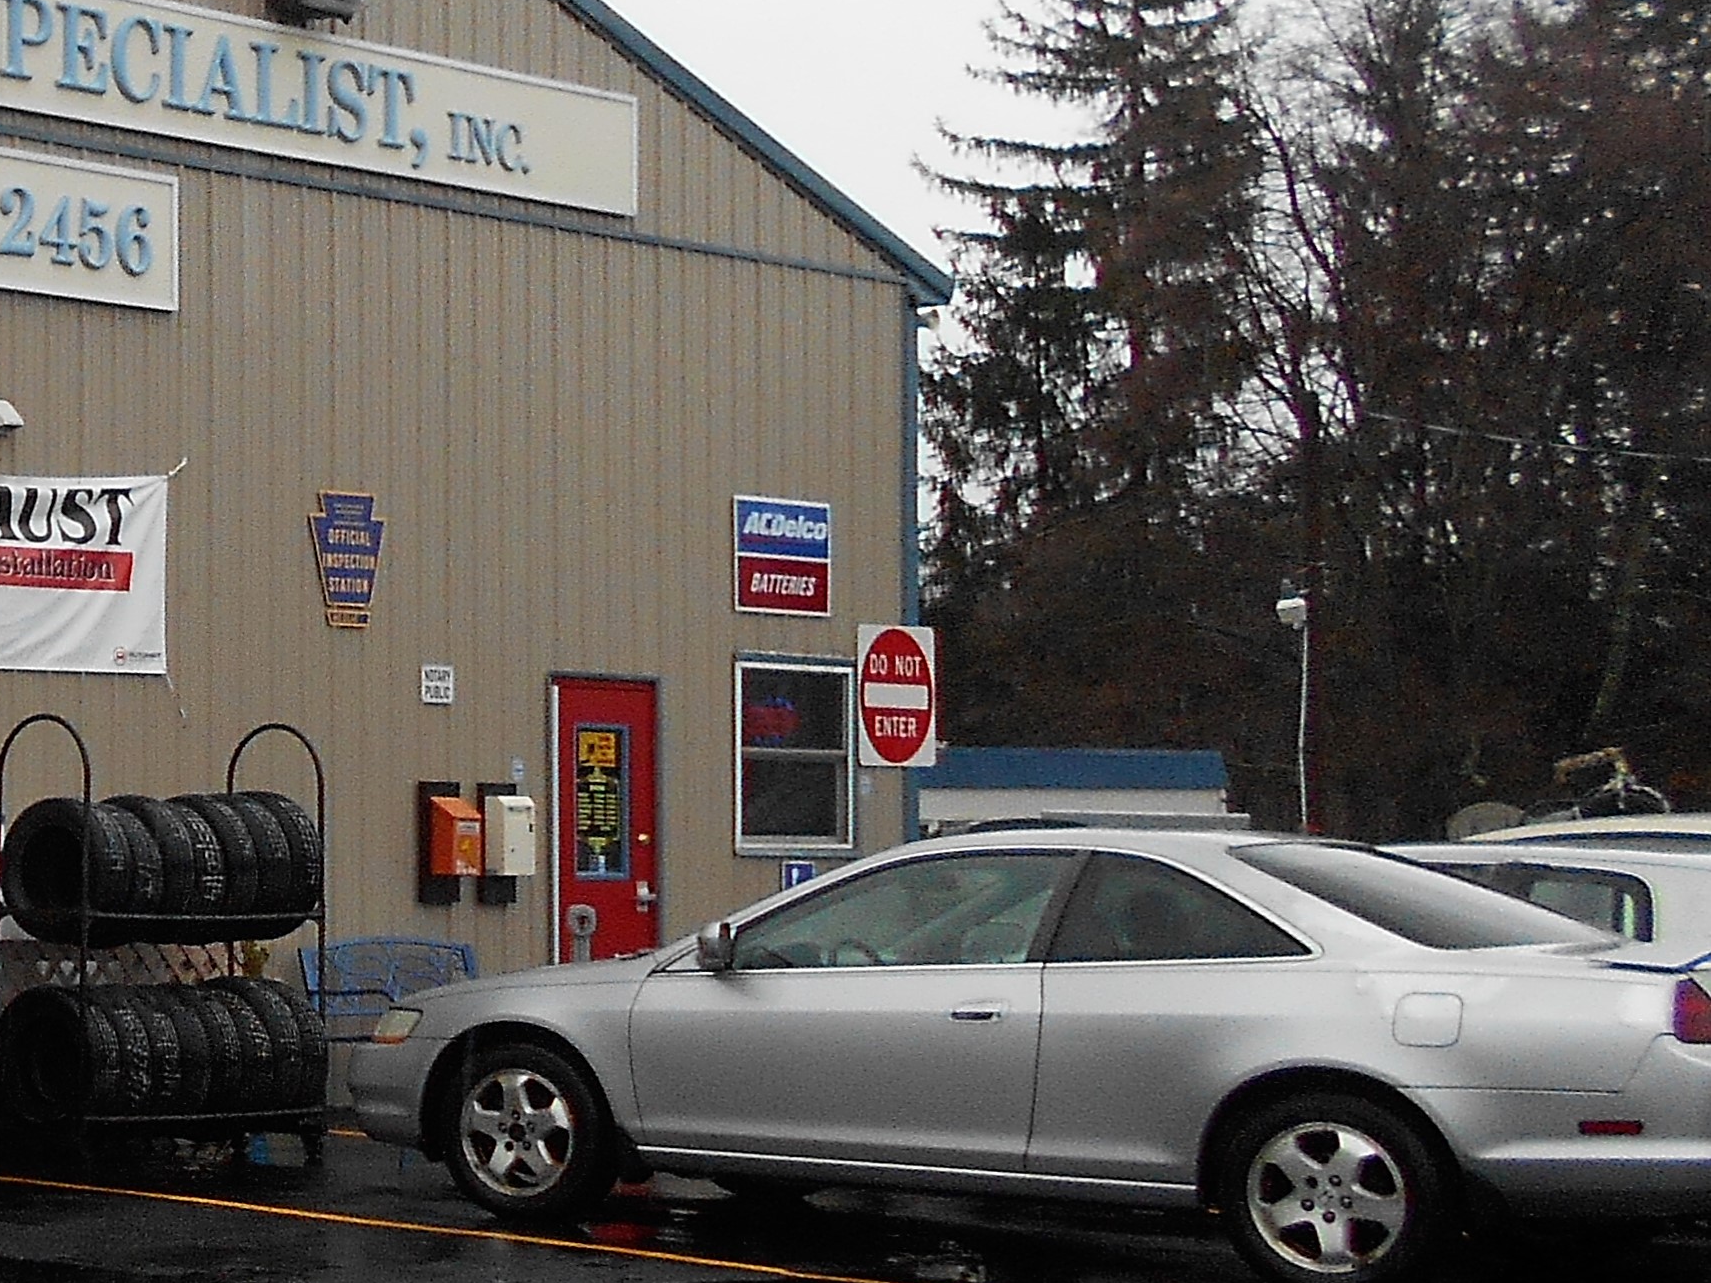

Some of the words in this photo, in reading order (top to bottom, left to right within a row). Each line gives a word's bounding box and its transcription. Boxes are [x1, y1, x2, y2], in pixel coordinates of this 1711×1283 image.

[446, 111, 532, 176] INC.
[742, 511, 827, 541] ACDelco
[327, 528, 371, 547] OFFICIAL
[321, 553, 377, 570] INSPECTION
[327, 576, 369, 594] STATION
[750, 572, 818, 597] BATTERIES
[869, 653, 888, 675] DO
[894, 655, 922, 678] NOT
[423, 669, 451, 684] NOTARY
[423, 684, 451, 701] PUBLIC
[874, 715, 918, 738] ENTER
